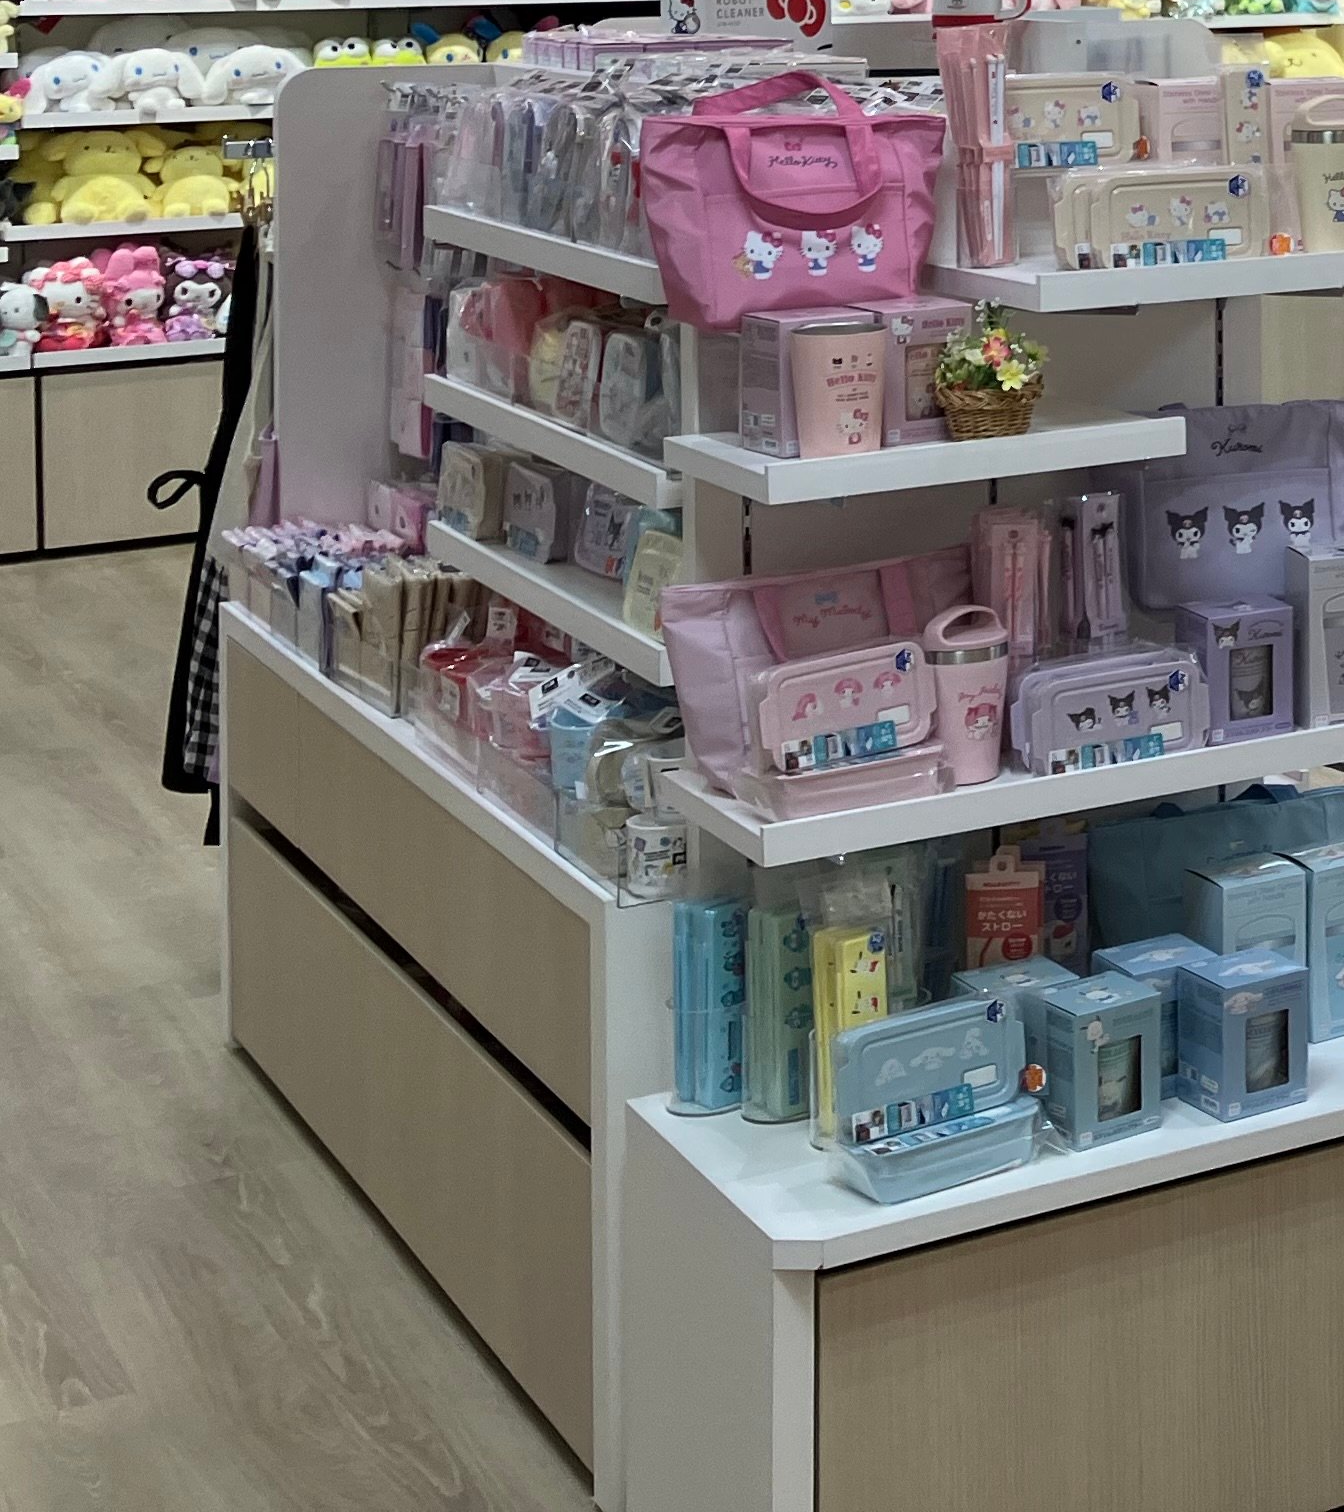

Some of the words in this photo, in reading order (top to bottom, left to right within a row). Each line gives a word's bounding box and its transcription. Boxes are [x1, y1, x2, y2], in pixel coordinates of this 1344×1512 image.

[716, 7, 765, 19] CLEANER
[768, 155, 802, 168] Hello
[801, 155, 838, 169] Kitty
[977, 909, 1027, 921] かたくない
[982, 922, 1024, 932] ストロー
